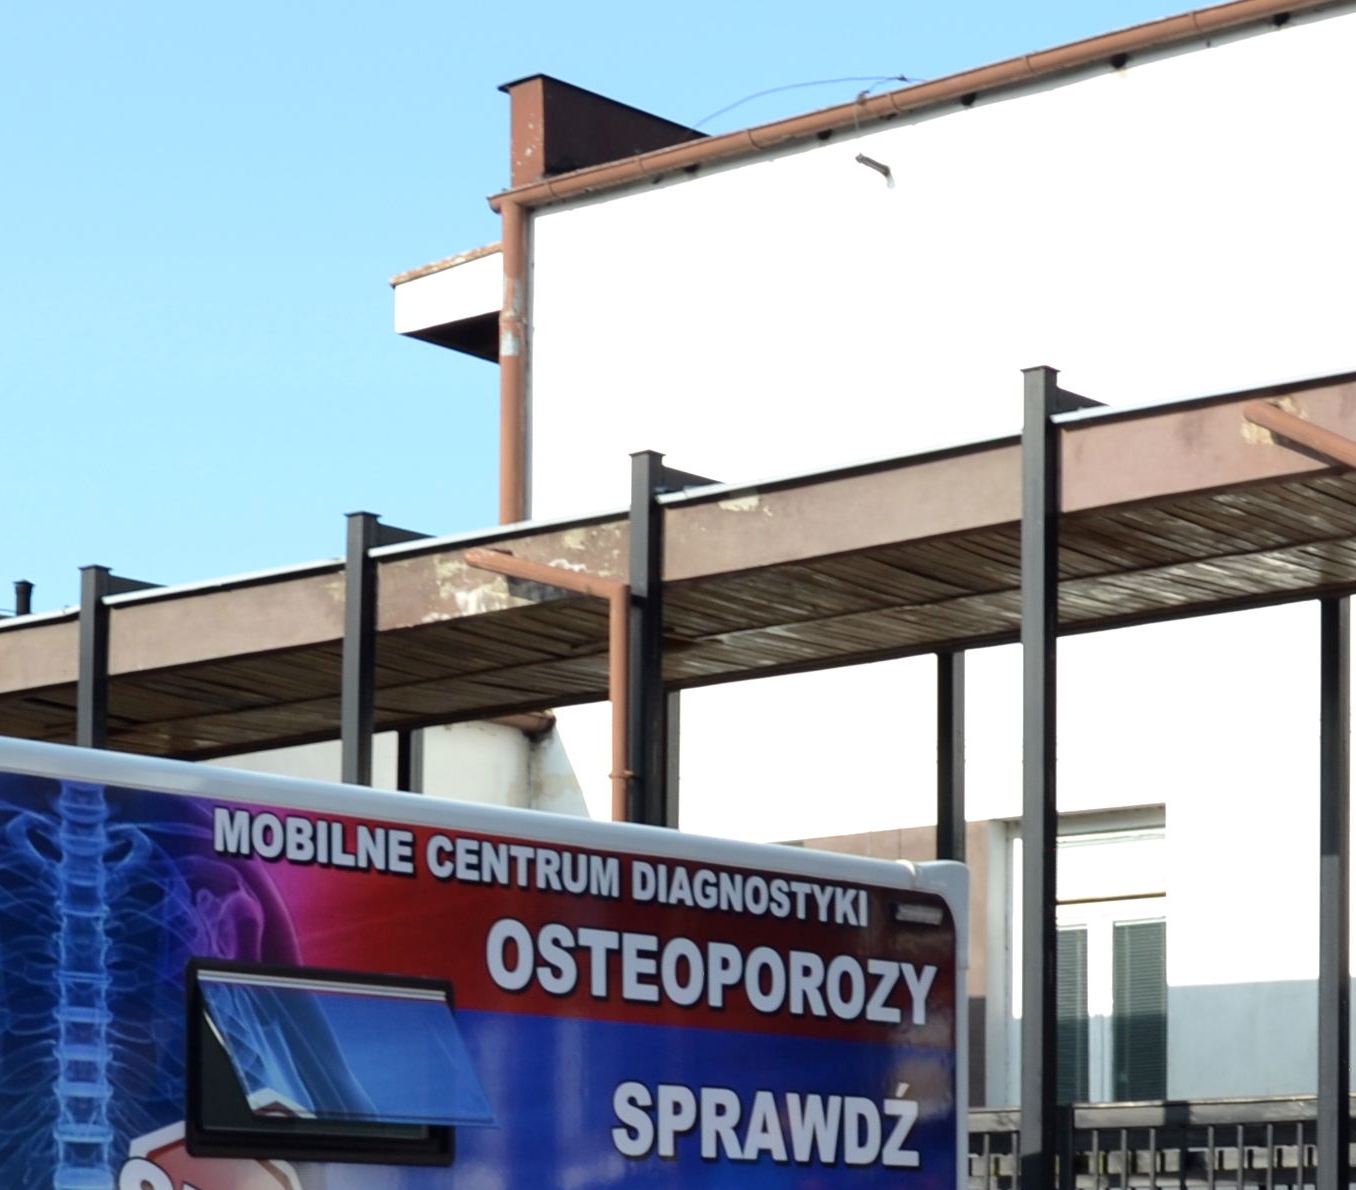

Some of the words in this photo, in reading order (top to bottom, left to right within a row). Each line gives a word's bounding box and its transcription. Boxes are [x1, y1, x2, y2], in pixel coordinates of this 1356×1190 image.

[212, 807, 416, 876] MOBILNE
[426, 837, 622, 900] CENTRUM
[633, 862, 870, 929] DIAGNOSTYKI
[486, 918, 938, 1027] OSTEOPOROZY
[610, 1082, 921, 1168] SPRAWDŹ
